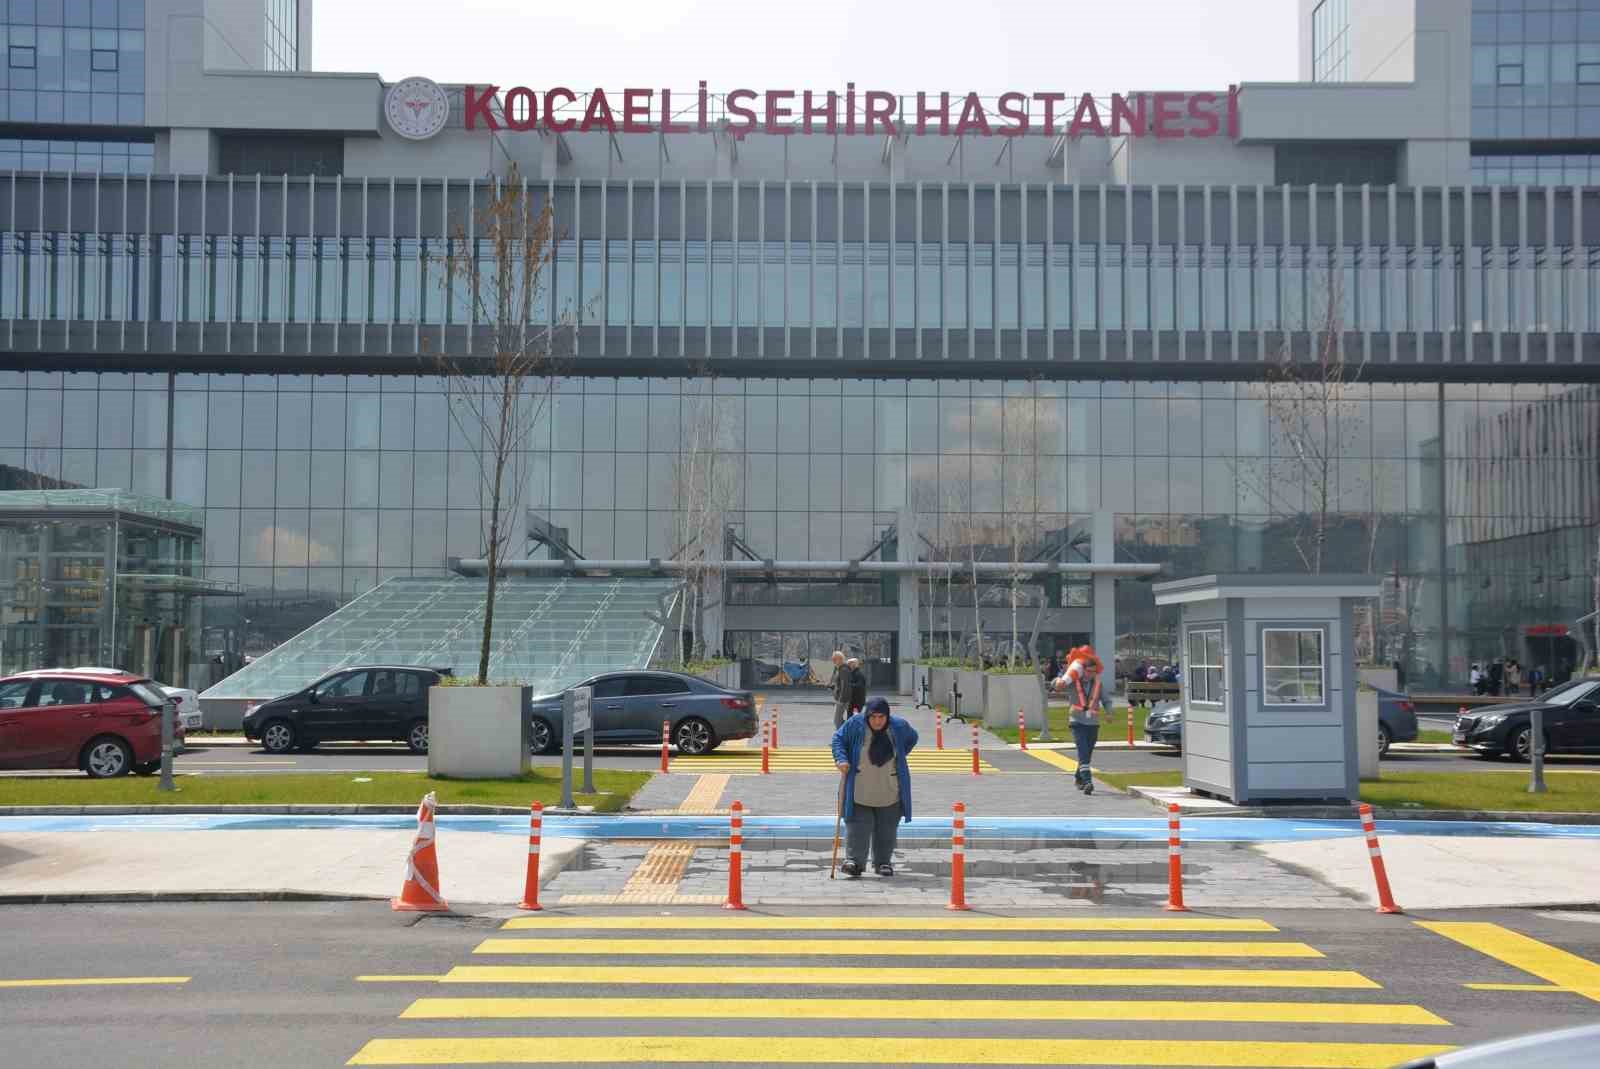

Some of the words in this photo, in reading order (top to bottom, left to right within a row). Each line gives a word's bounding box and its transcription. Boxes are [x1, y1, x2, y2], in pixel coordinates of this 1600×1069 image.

[464, 80, 707, 133] KOCAELİ
[726, 82, 897, 141] ŞEHİR
[916, 84, 1240, 138] HASTANESİ
